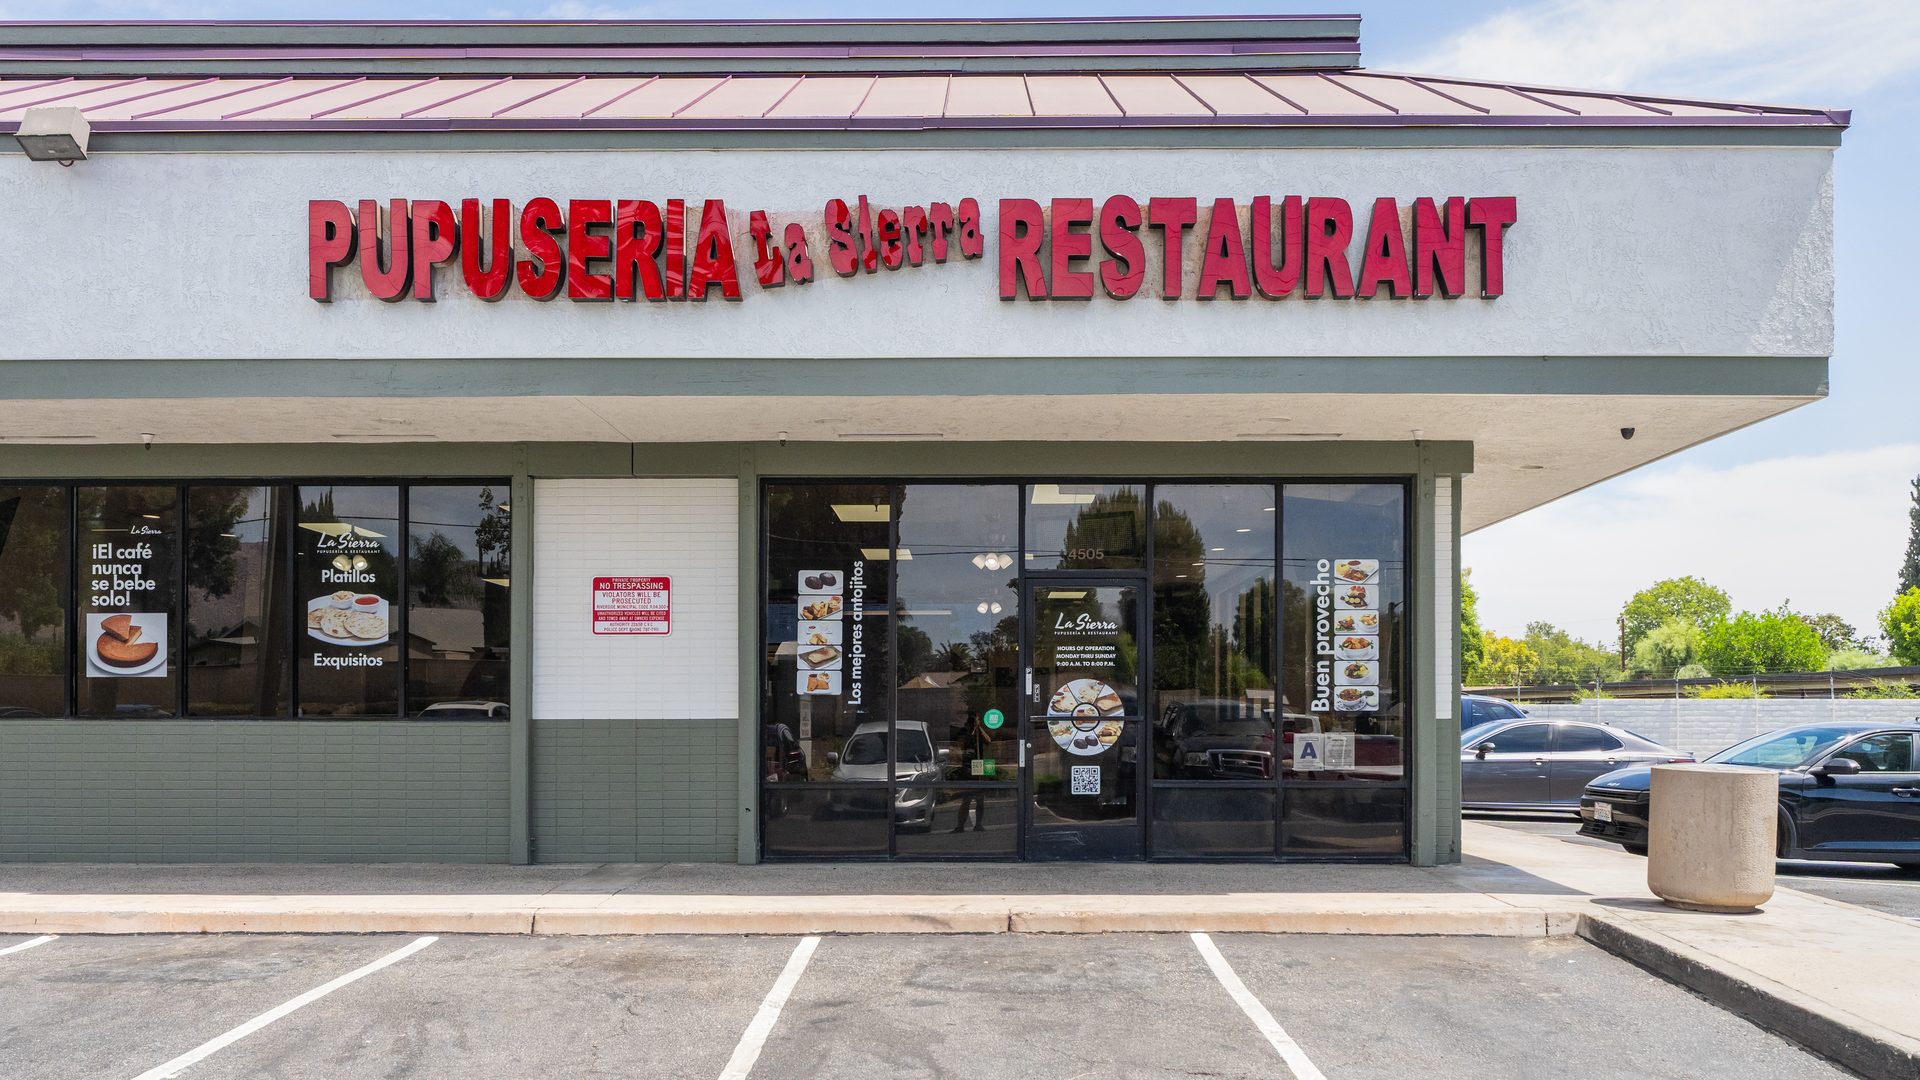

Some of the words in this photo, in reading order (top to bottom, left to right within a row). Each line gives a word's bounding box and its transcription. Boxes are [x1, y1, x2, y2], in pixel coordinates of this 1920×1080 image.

[308, 197, 743, 303] PUPUSERIA
[750, 210, 814, 289] La
[824, 194, 985, 278] Sierra
[999, 195, 1517, 300] RESTAURANT
[130, 525, 140, 535] La
[141, 525, 162, 535] Sierra
[317, 532, 337, 548] La
[338, 531, 380, 549] Sierra
[116, 542, 152, 559] café
[1068, 548, 1105, 560] 4505
[92, 564, 142, 575] nunca
[321, 568, 376, 583] Platillos
[91, 579, 109, 591] se
[113, 574, 156, 590] bebe
[849, 560, 867, 621] antojitos
[91, 590, 130, 606] solo!
[1309, 558, 1335, 655] provecho
[1054, 612, 1075, 629] La
[1075, 613, 1118, 630] Sierra
[848, 623, 866, 680] mejores
[313, 652, 383, 670] Exquisitos
[847, 682, 862, 705] Los
[1310, 660, 1330, 712] Buen
[1300, 741, 1318, 759] A
